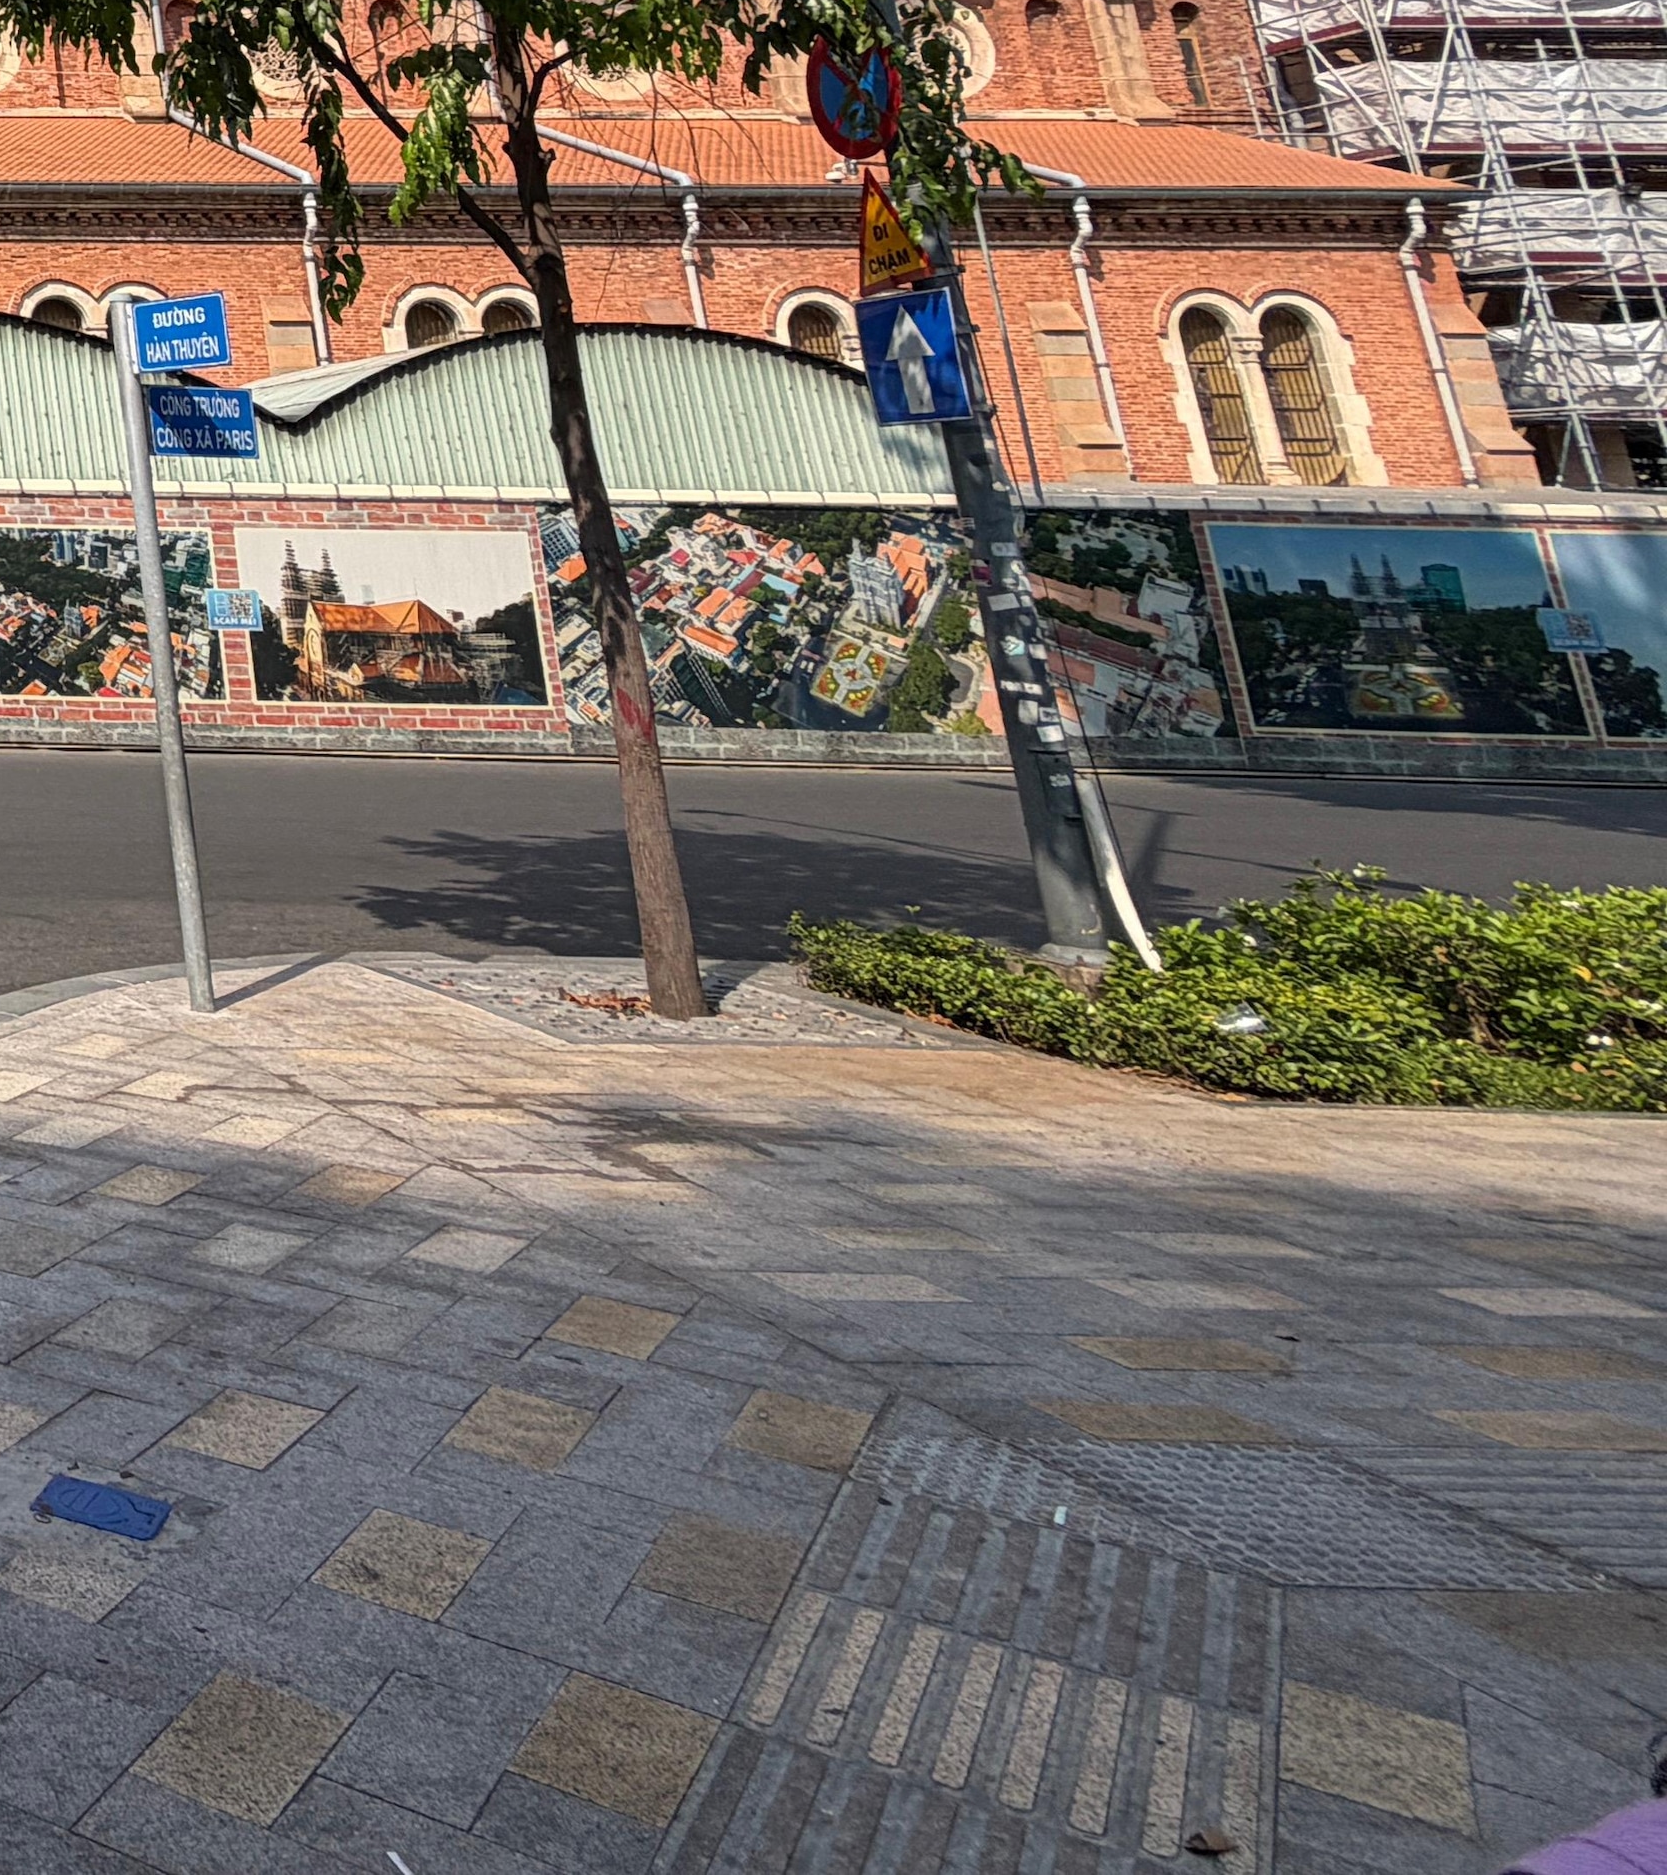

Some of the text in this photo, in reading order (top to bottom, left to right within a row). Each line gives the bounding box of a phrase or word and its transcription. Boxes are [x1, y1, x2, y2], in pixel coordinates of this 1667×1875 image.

[868, 248, 911, 275] CHẬM
[152, 306, 206, 329] ĐƯỜNG
[145, 331, 220, 364] HÀN THUYÊN
[159, 391, 240, 418] CÔNG TRƯỜNG
[156, 423, 254, 451] CÔNG XÃ PARIS
